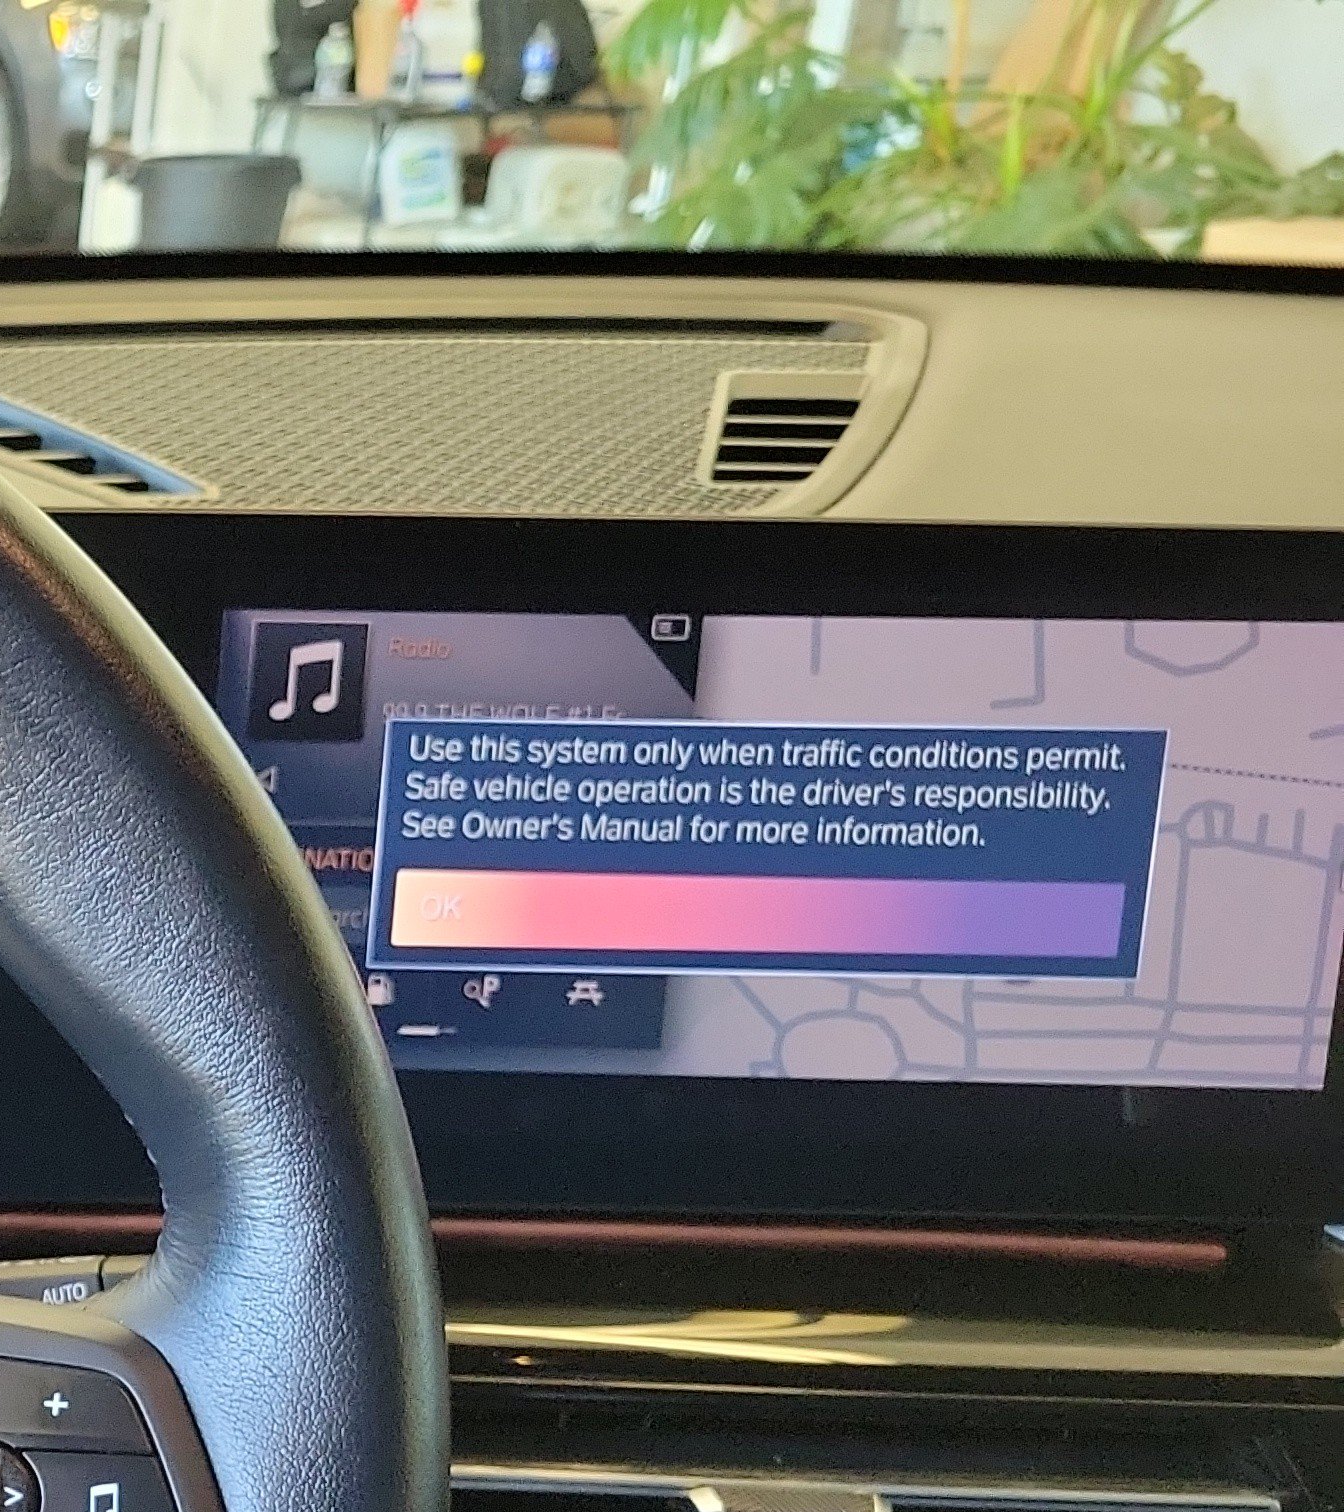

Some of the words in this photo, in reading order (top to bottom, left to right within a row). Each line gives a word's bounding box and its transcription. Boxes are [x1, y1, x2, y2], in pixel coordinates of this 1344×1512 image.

[409, 734, 462, 763] Use
[471, 733, 520, 763] this
[527, 738, 627, 769] system
[633, 738, 694, 771] only
[700, 738, 773, 766] when
[781, 738, 862, 768] traffic
[869, 740, 1019, 771] conditions
[1025, 743, 1127, 775] permit.
[405, 770, 467, 800] Safe
[474, 773, 570, 801] vehicle
[578, 775, 711, 808] operation
[720, 778, 743, 805] is
[749, 777, 795, 806] the
[804, 778, 906, 808] driver's
[914, 780, 1111, 815] responsibility.
[402, 810, 455, 839] See
[462, 810, 574, 842] Owner's
[581, 813, 682, 843] Manual
[689, 814, 728, 843] for
[736, 820, 808, 846] more
[817, 816, 986, 848] information.
[419, 893, 462, 921] OK
[42, 1282, 87, 1306] AUTO
